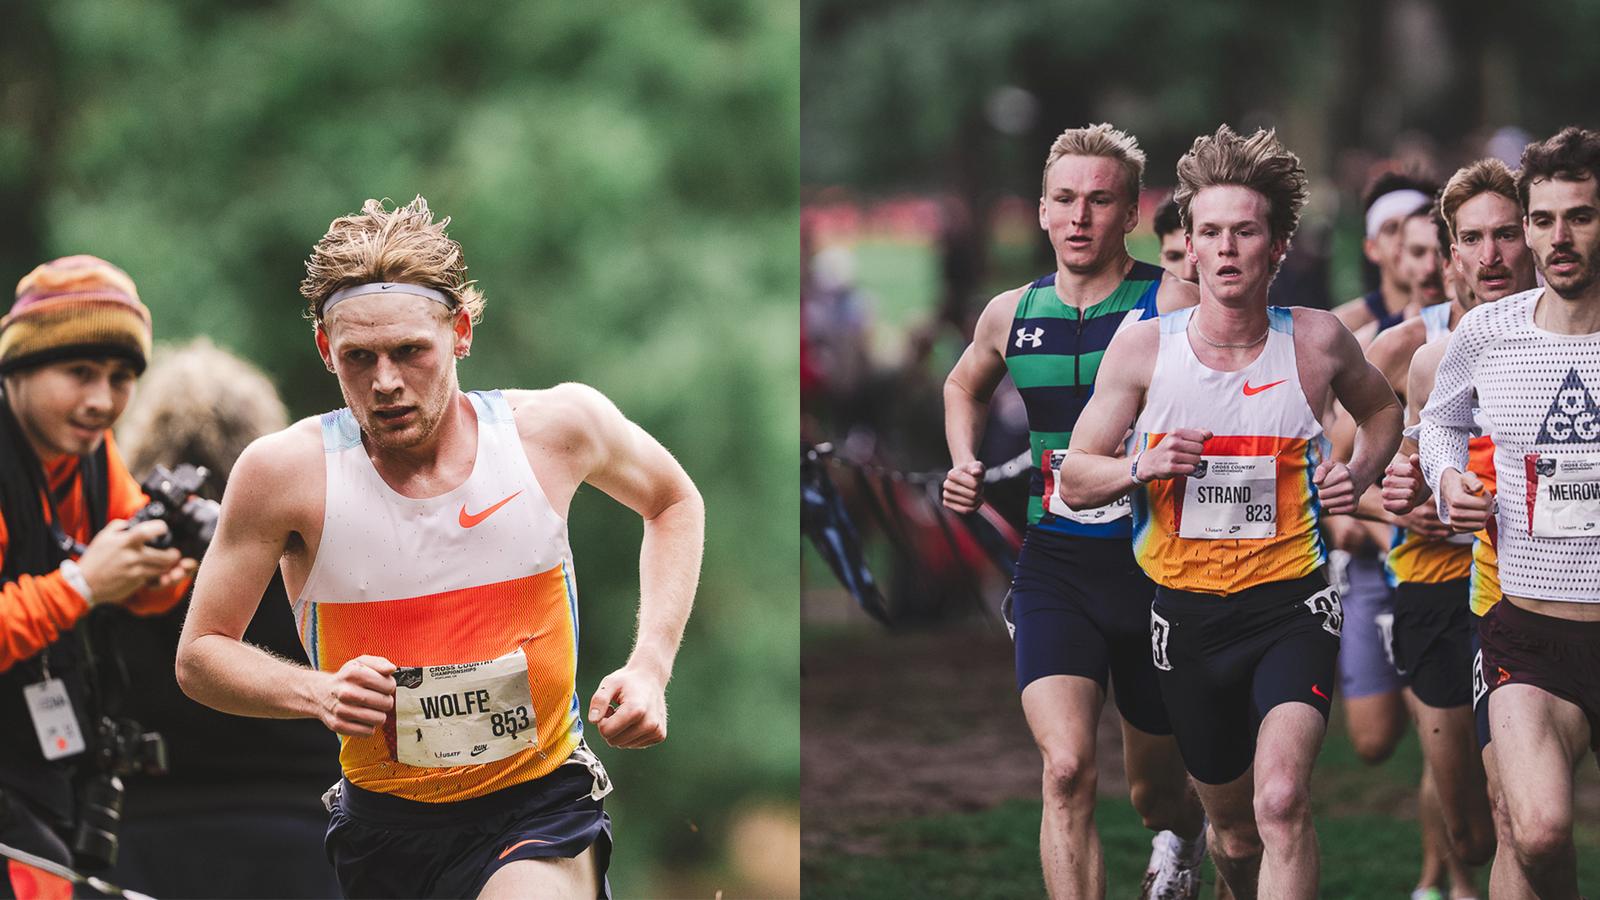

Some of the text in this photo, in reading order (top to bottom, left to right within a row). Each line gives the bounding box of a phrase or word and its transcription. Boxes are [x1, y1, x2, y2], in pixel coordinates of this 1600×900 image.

[1197, 485, 1252, 504] STRAND
[1245, 504, 1272, 522] 823
[429, 664, 456, 673] CROSS
[430, 667, 477, 678] CHAMPIONSHIPS
[420, 689, 491, 720] WOLFE
[490, 705, 530, 738] 853
[473, 743, 488, 752] RUN
